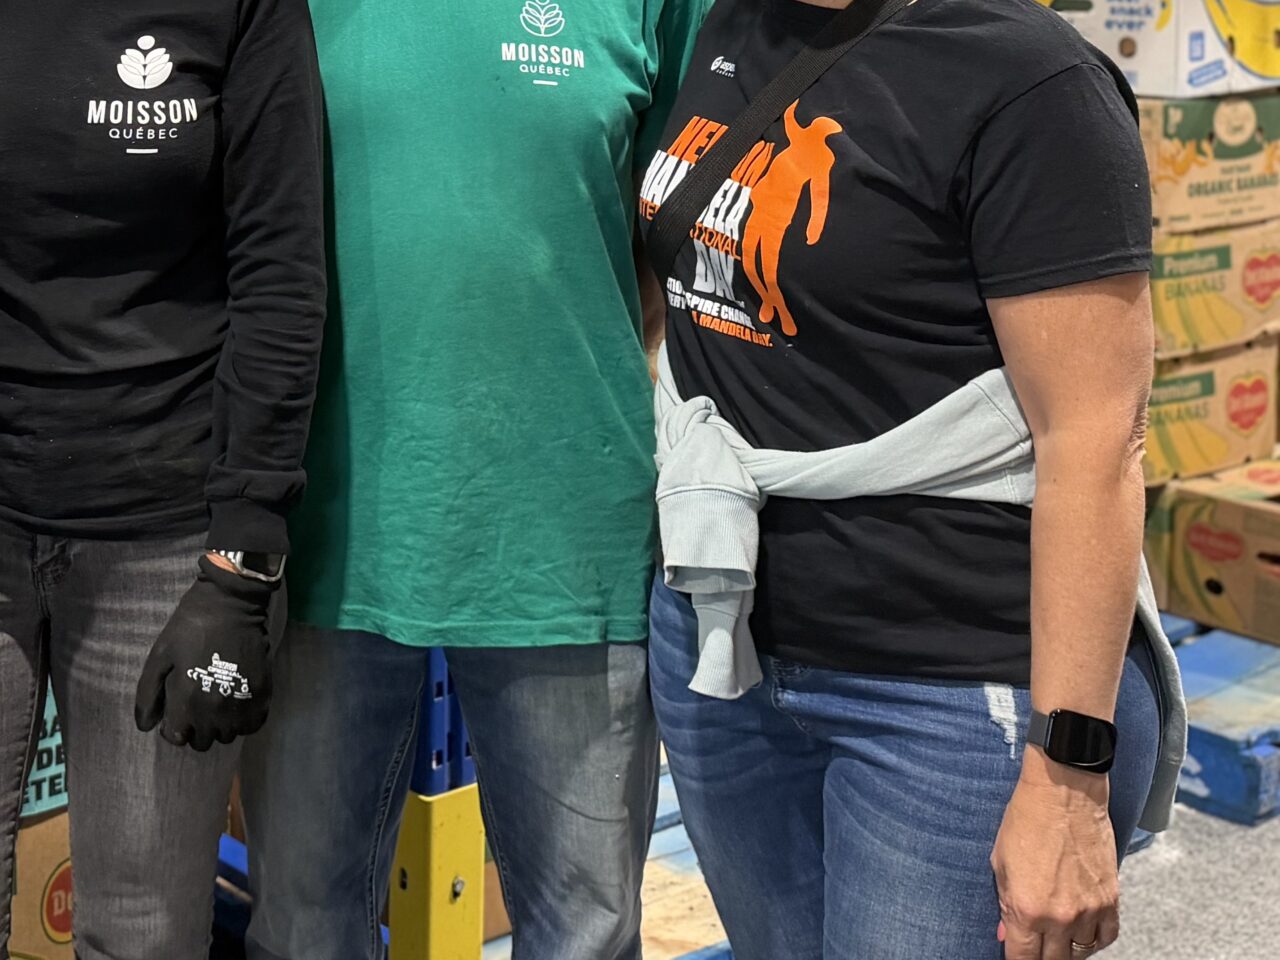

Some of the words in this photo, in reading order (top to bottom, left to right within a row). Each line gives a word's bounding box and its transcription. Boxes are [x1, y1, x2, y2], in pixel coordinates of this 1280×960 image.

[502, 43, 584, 68] MOISSON
[519, 64, 570, 77] QUÉBEC
[87, 98, 198, 124] MOISSON
[108, 127, 178, 139] QUÉBEC
[700, 314, 752, 342] MANDELA
